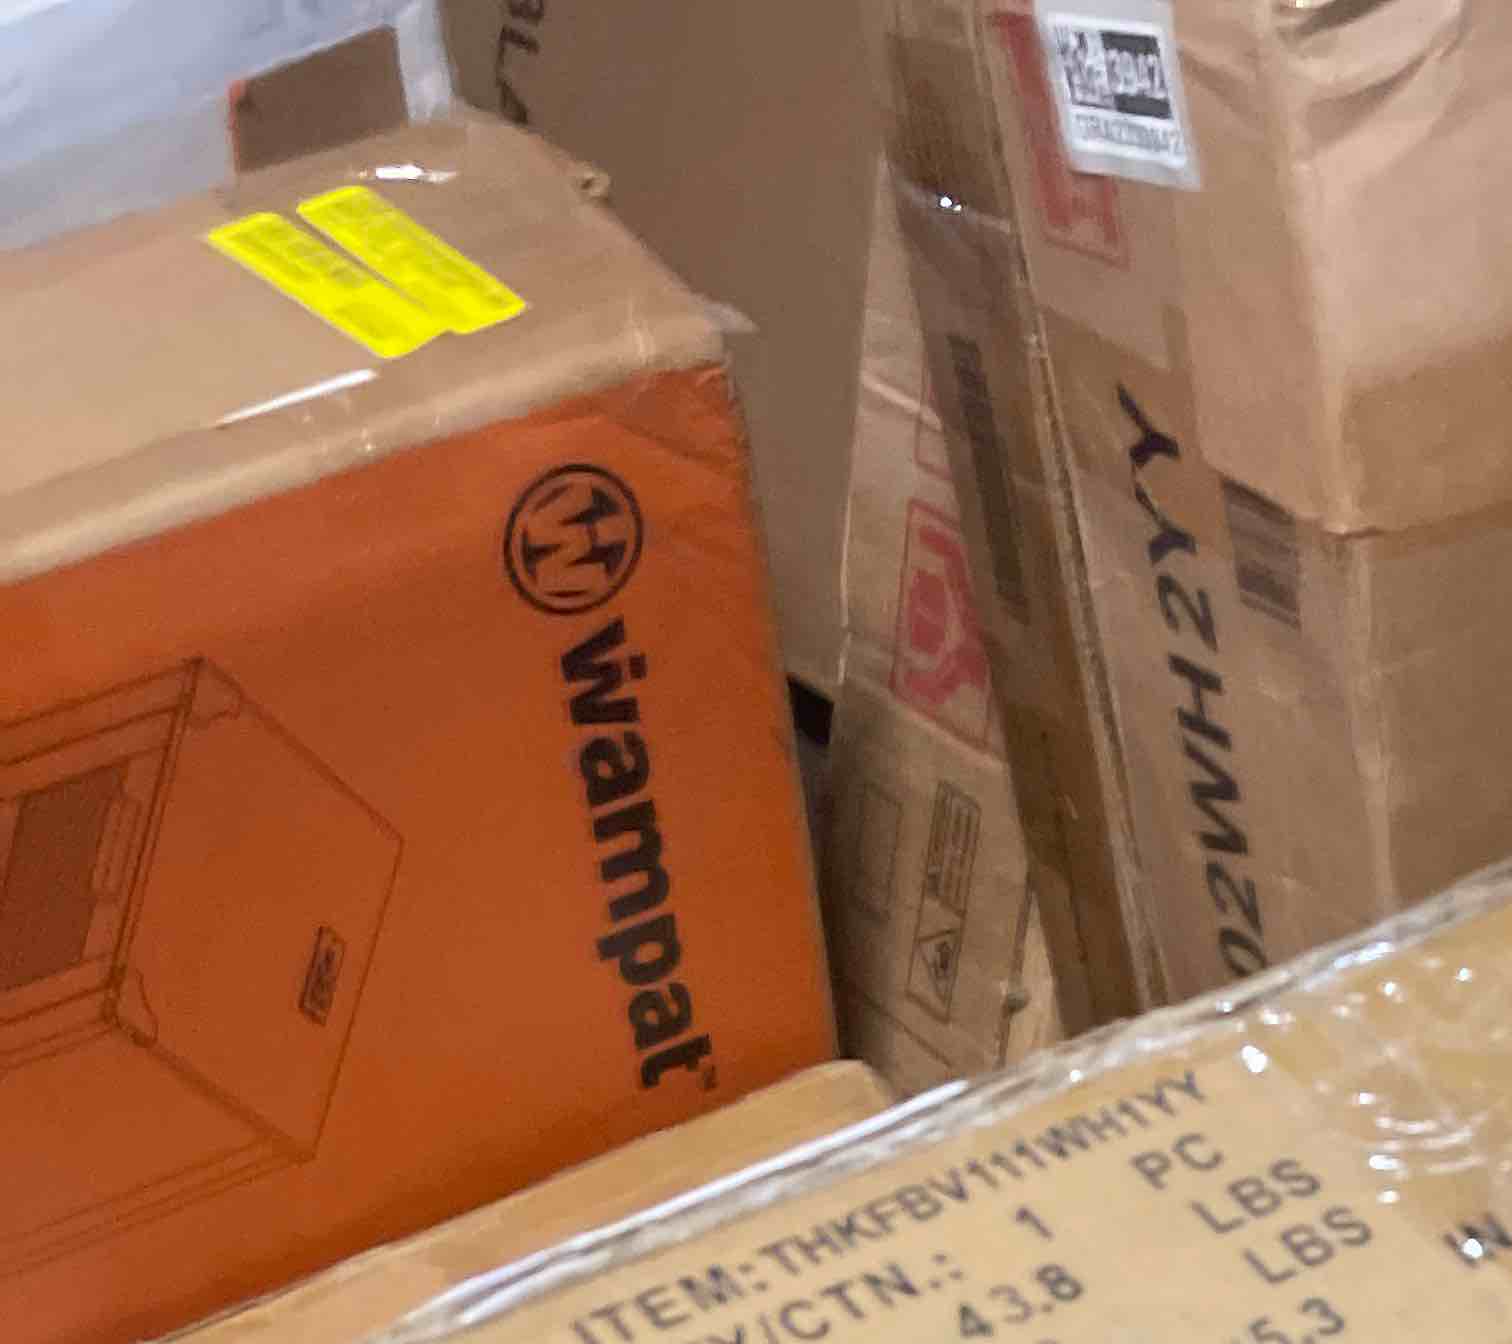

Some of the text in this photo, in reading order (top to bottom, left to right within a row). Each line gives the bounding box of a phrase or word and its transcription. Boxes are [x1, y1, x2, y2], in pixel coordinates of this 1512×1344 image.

[1015, 1206, 1054, 1242] 1
[1130, 1132, 1226, 1191] PC
[957, 1263, 1085, 1341] 43.8
[1190, 1157, 1322, 1236] LBS
[1242, 1205, 1374, 1286] LBS
